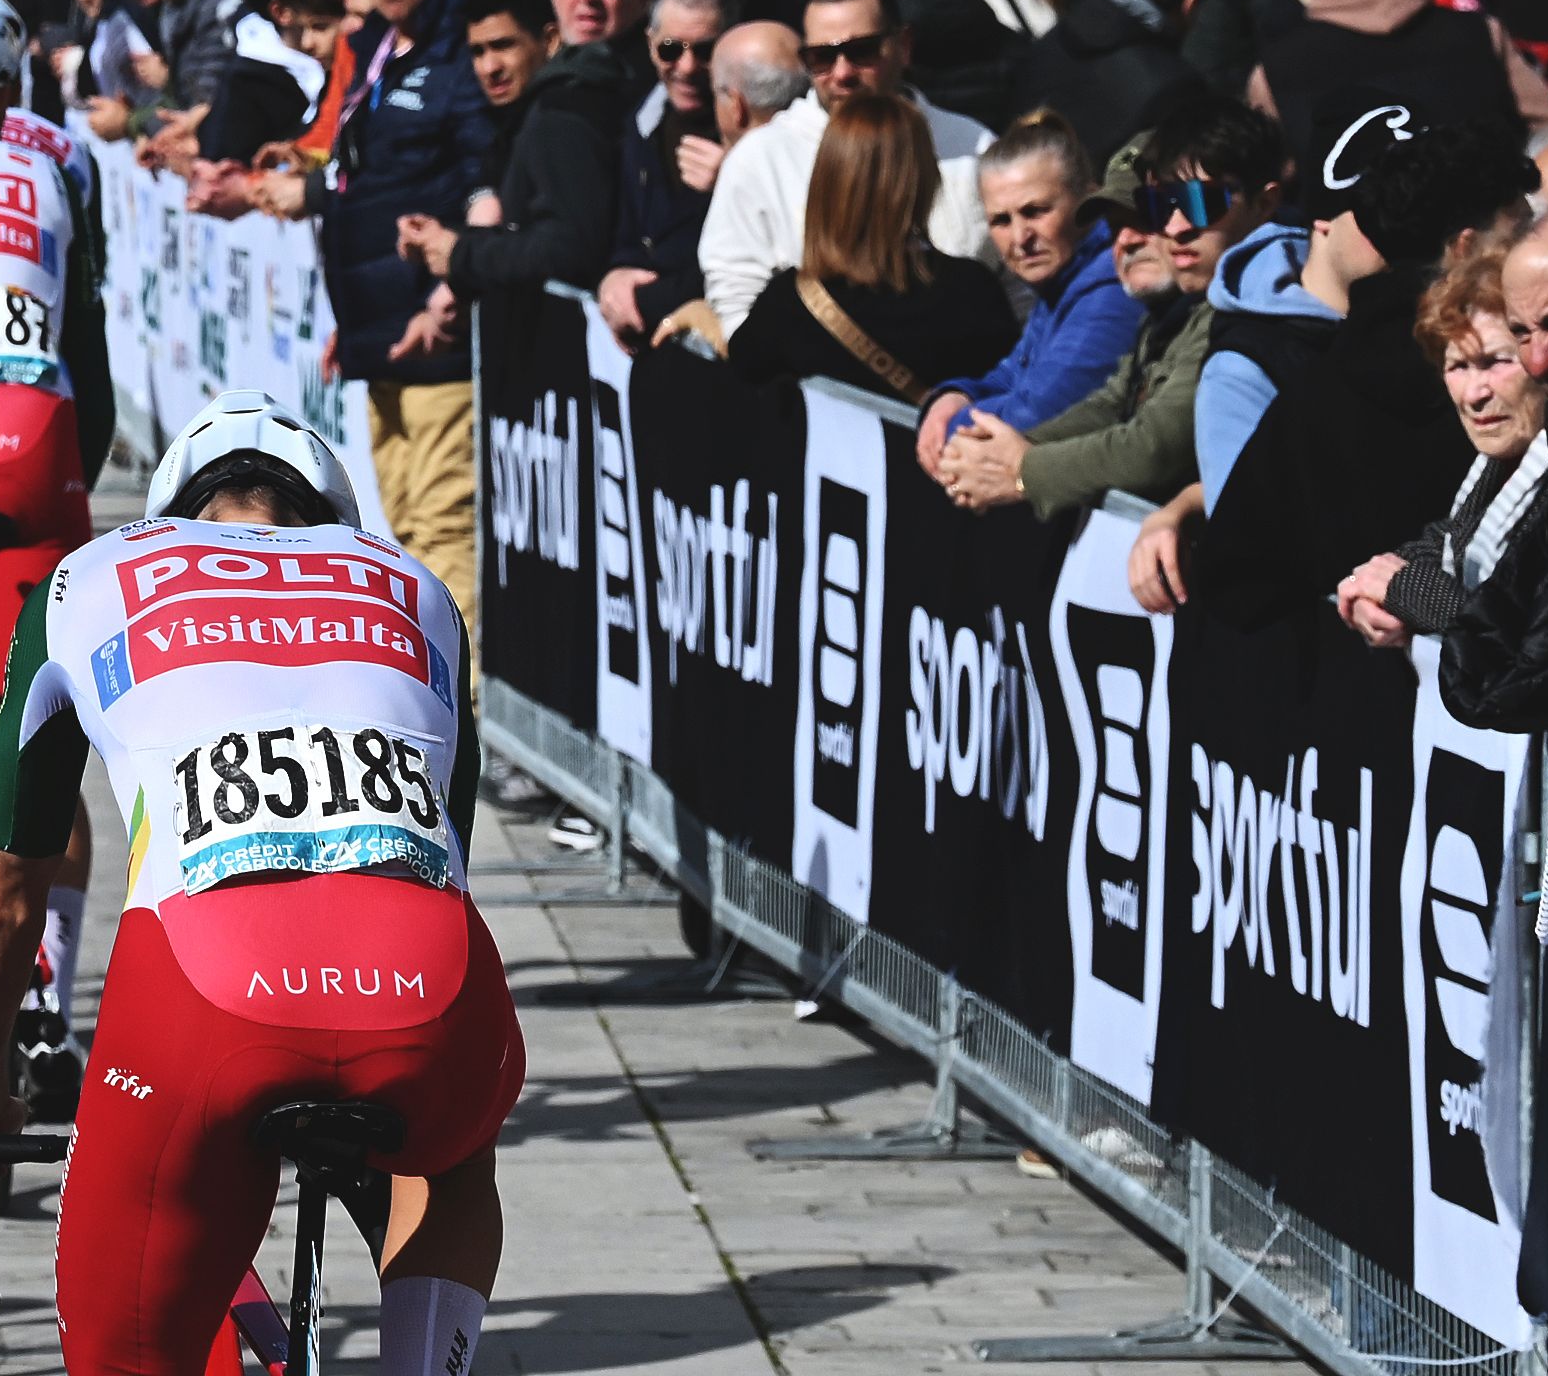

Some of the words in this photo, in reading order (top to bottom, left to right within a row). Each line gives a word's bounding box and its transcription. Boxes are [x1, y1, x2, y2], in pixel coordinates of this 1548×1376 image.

[491, 389, 580, 587] sportful
[134, 553, 407, 609] POLTI
[653, 477, 779, 687] sportful
[142, 614, 417, 659] VisitMalta
[175, 726, 309, 846] 185
[311, 726, 441, 830] 185
[220, 842, 295, 864] CRÉDIT
[224, 854, 324, 879] AGRICOLE
[365, 835, 429, 864] CRÉDIT
[1192, 744, 1372, 1028] sportful
[247, 966, 426, 1000] AURUM
